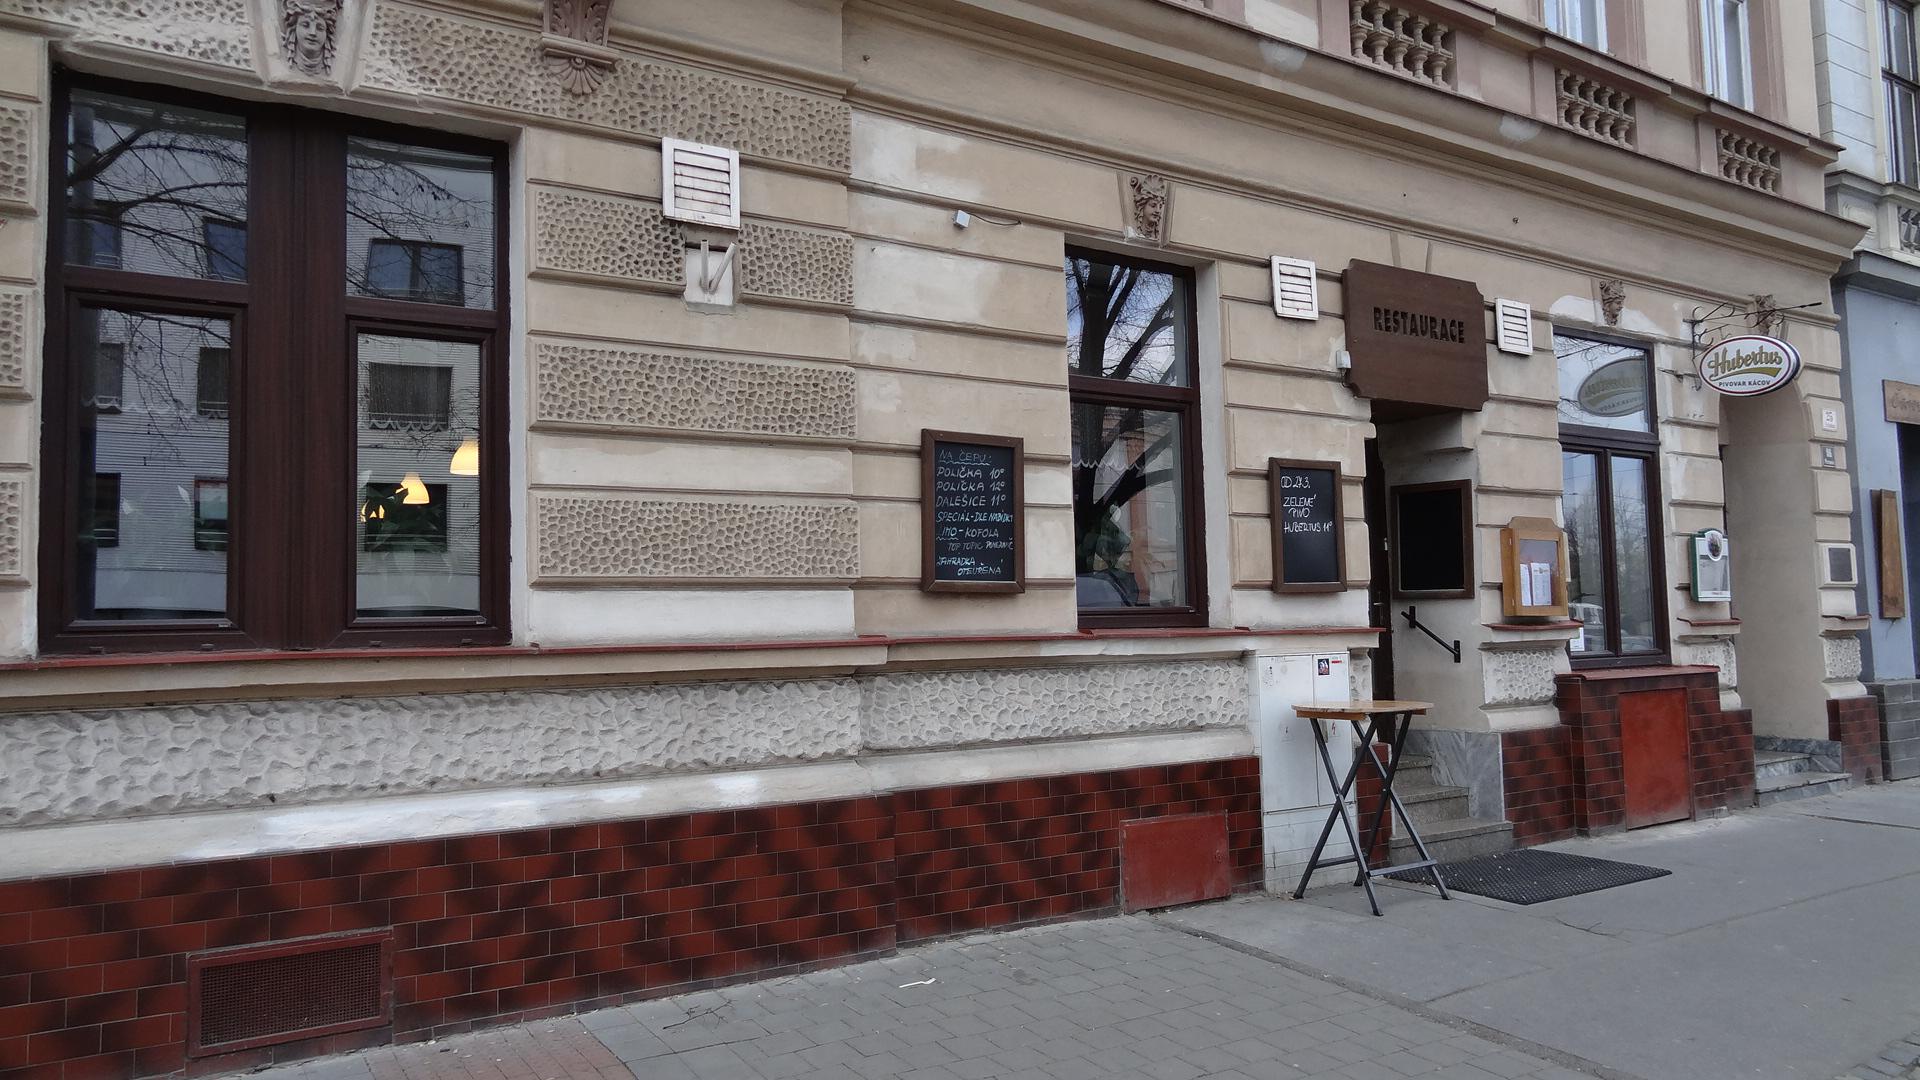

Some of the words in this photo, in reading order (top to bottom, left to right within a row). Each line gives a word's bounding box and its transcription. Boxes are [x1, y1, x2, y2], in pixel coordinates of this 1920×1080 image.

[1373, 306, 1465, 344] RESTAURACE
[1707, 345, 1783, 378] Hubertus
[939, 449, 953, 460] NA
[936, 466, 982, 479] POLIČKA
[936, 480, 985, 491] POLIČKA
[935, 494, 986, 507] DALEŠICE
[1288, 507, 1311, 518] PIVO
[964, 527, 999, 538] KOFOLA
[1283, 521, 1320, 533] HUBERTUS
